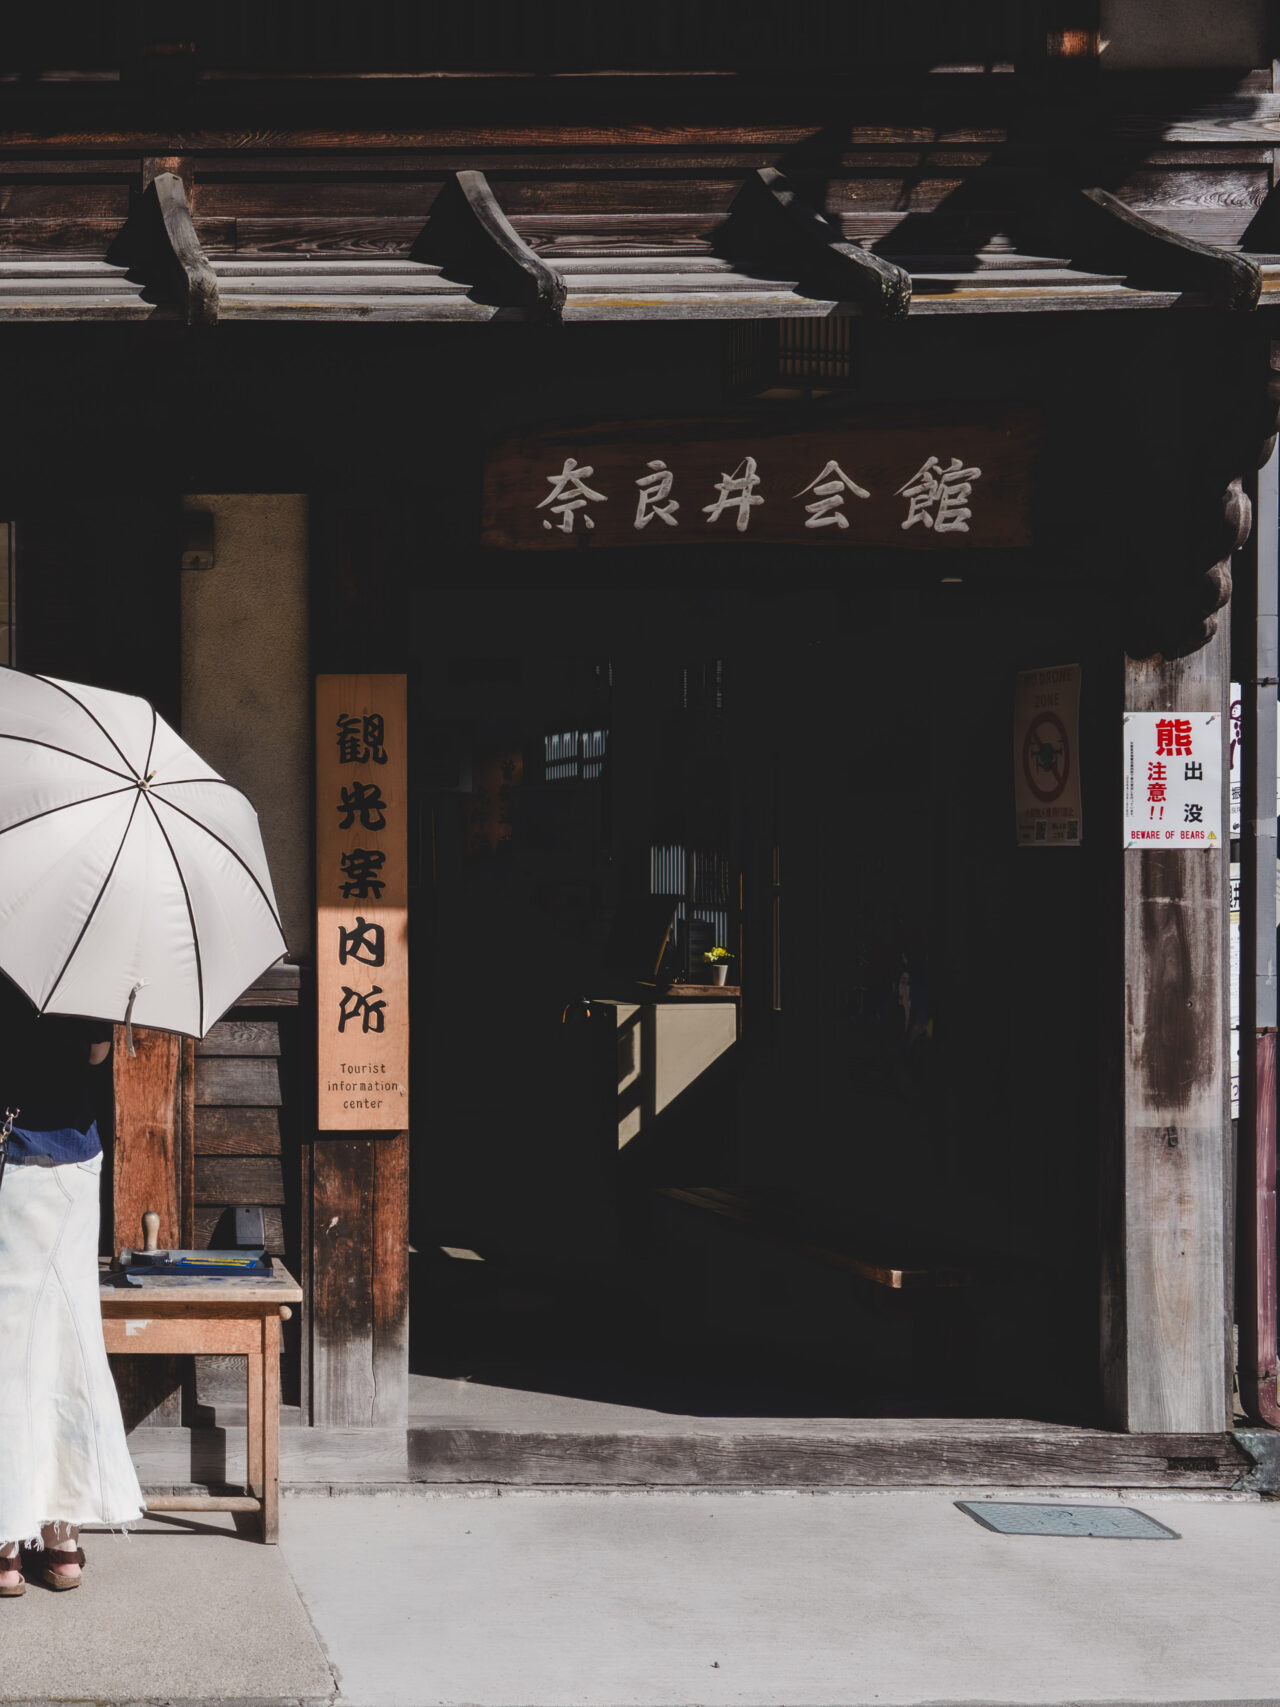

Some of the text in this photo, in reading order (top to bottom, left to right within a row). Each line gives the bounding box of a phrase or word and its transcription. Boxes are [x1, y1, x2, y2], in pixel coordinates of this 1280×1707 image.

[536, 456, 982, 533] 奈良井会館
[1034, 692, 1060, 708] ZONE
[1155, 719, 1193, 756] 熊
[1184, 761, 1203, 823] 出没
[1131, 830, 1205, 840] BEWARE OF BEARS
[336, 713, 388, 1033] 観光案内所
[340, 1063, 386, 1074] Tourist
[327, 1080, 399, 1091] information
[343, 1098, 383, 1109] center
